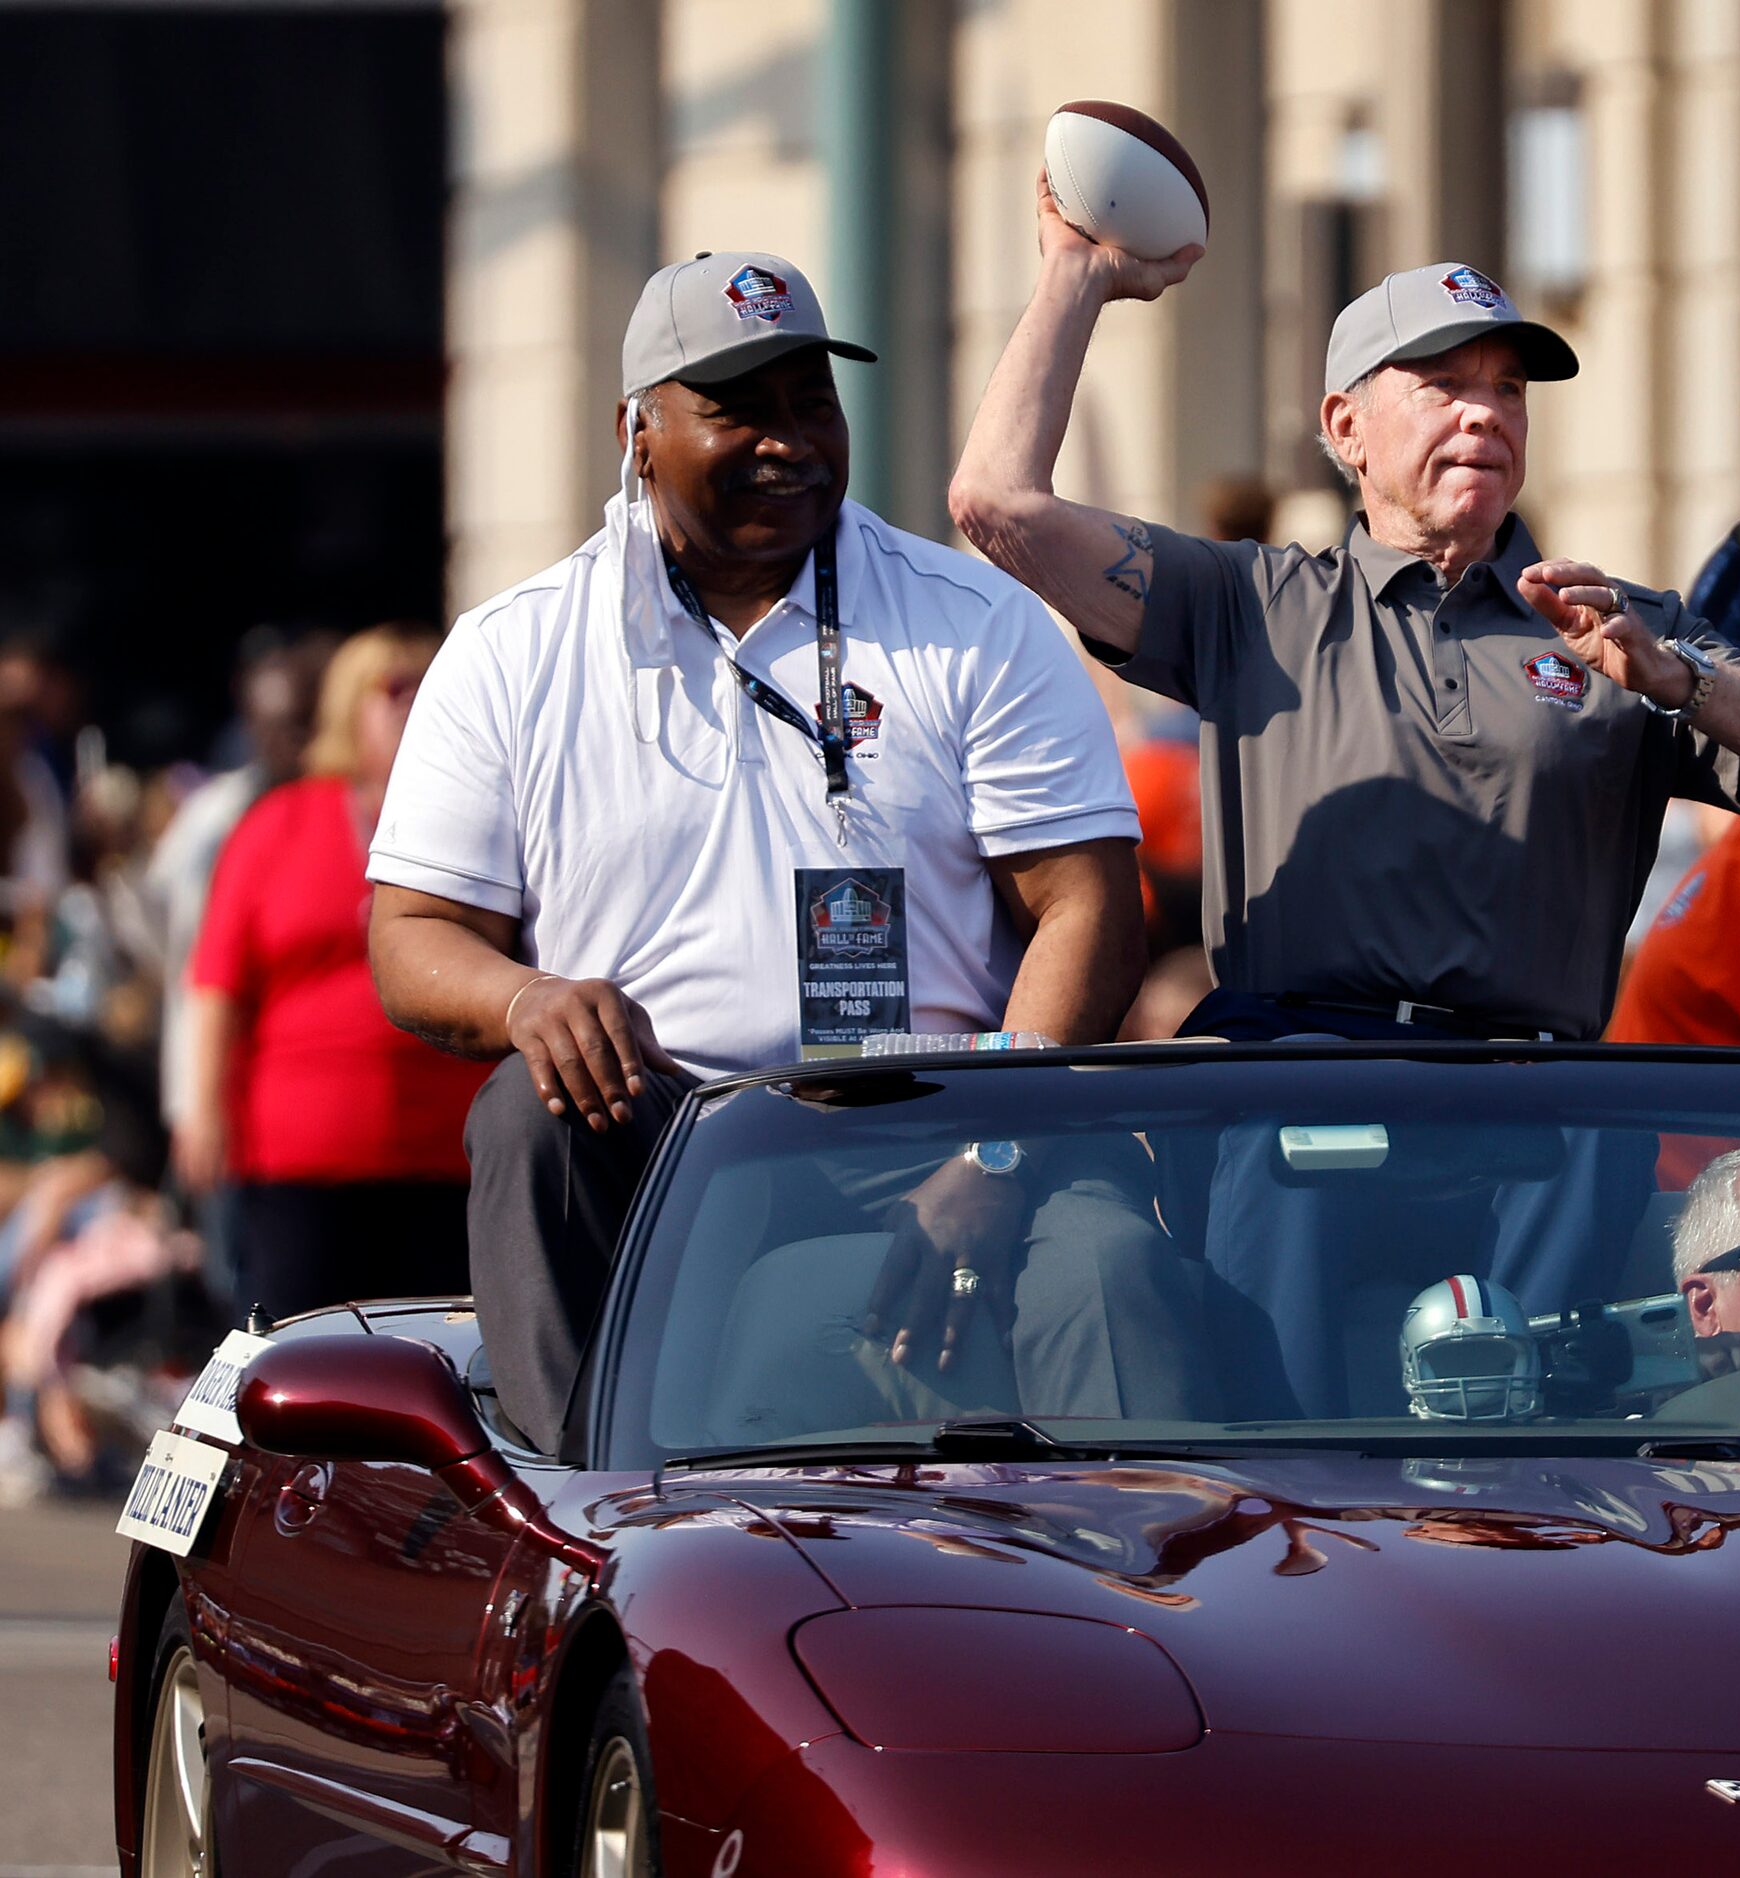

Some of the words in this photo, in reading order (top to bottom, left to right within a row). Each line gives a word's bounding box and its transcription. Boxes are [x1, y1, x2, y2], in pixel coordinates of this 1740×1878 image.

[851, 726, 877, 737] FAME
[821, 933, 849, 945] HALL
[856, 932, 883, 944] FAME
[803, 981, 905, 998] TRANSPORTATION
[840, 999, 871, 1016] PASS
[149, 1471, 208, 1537] LANIER
